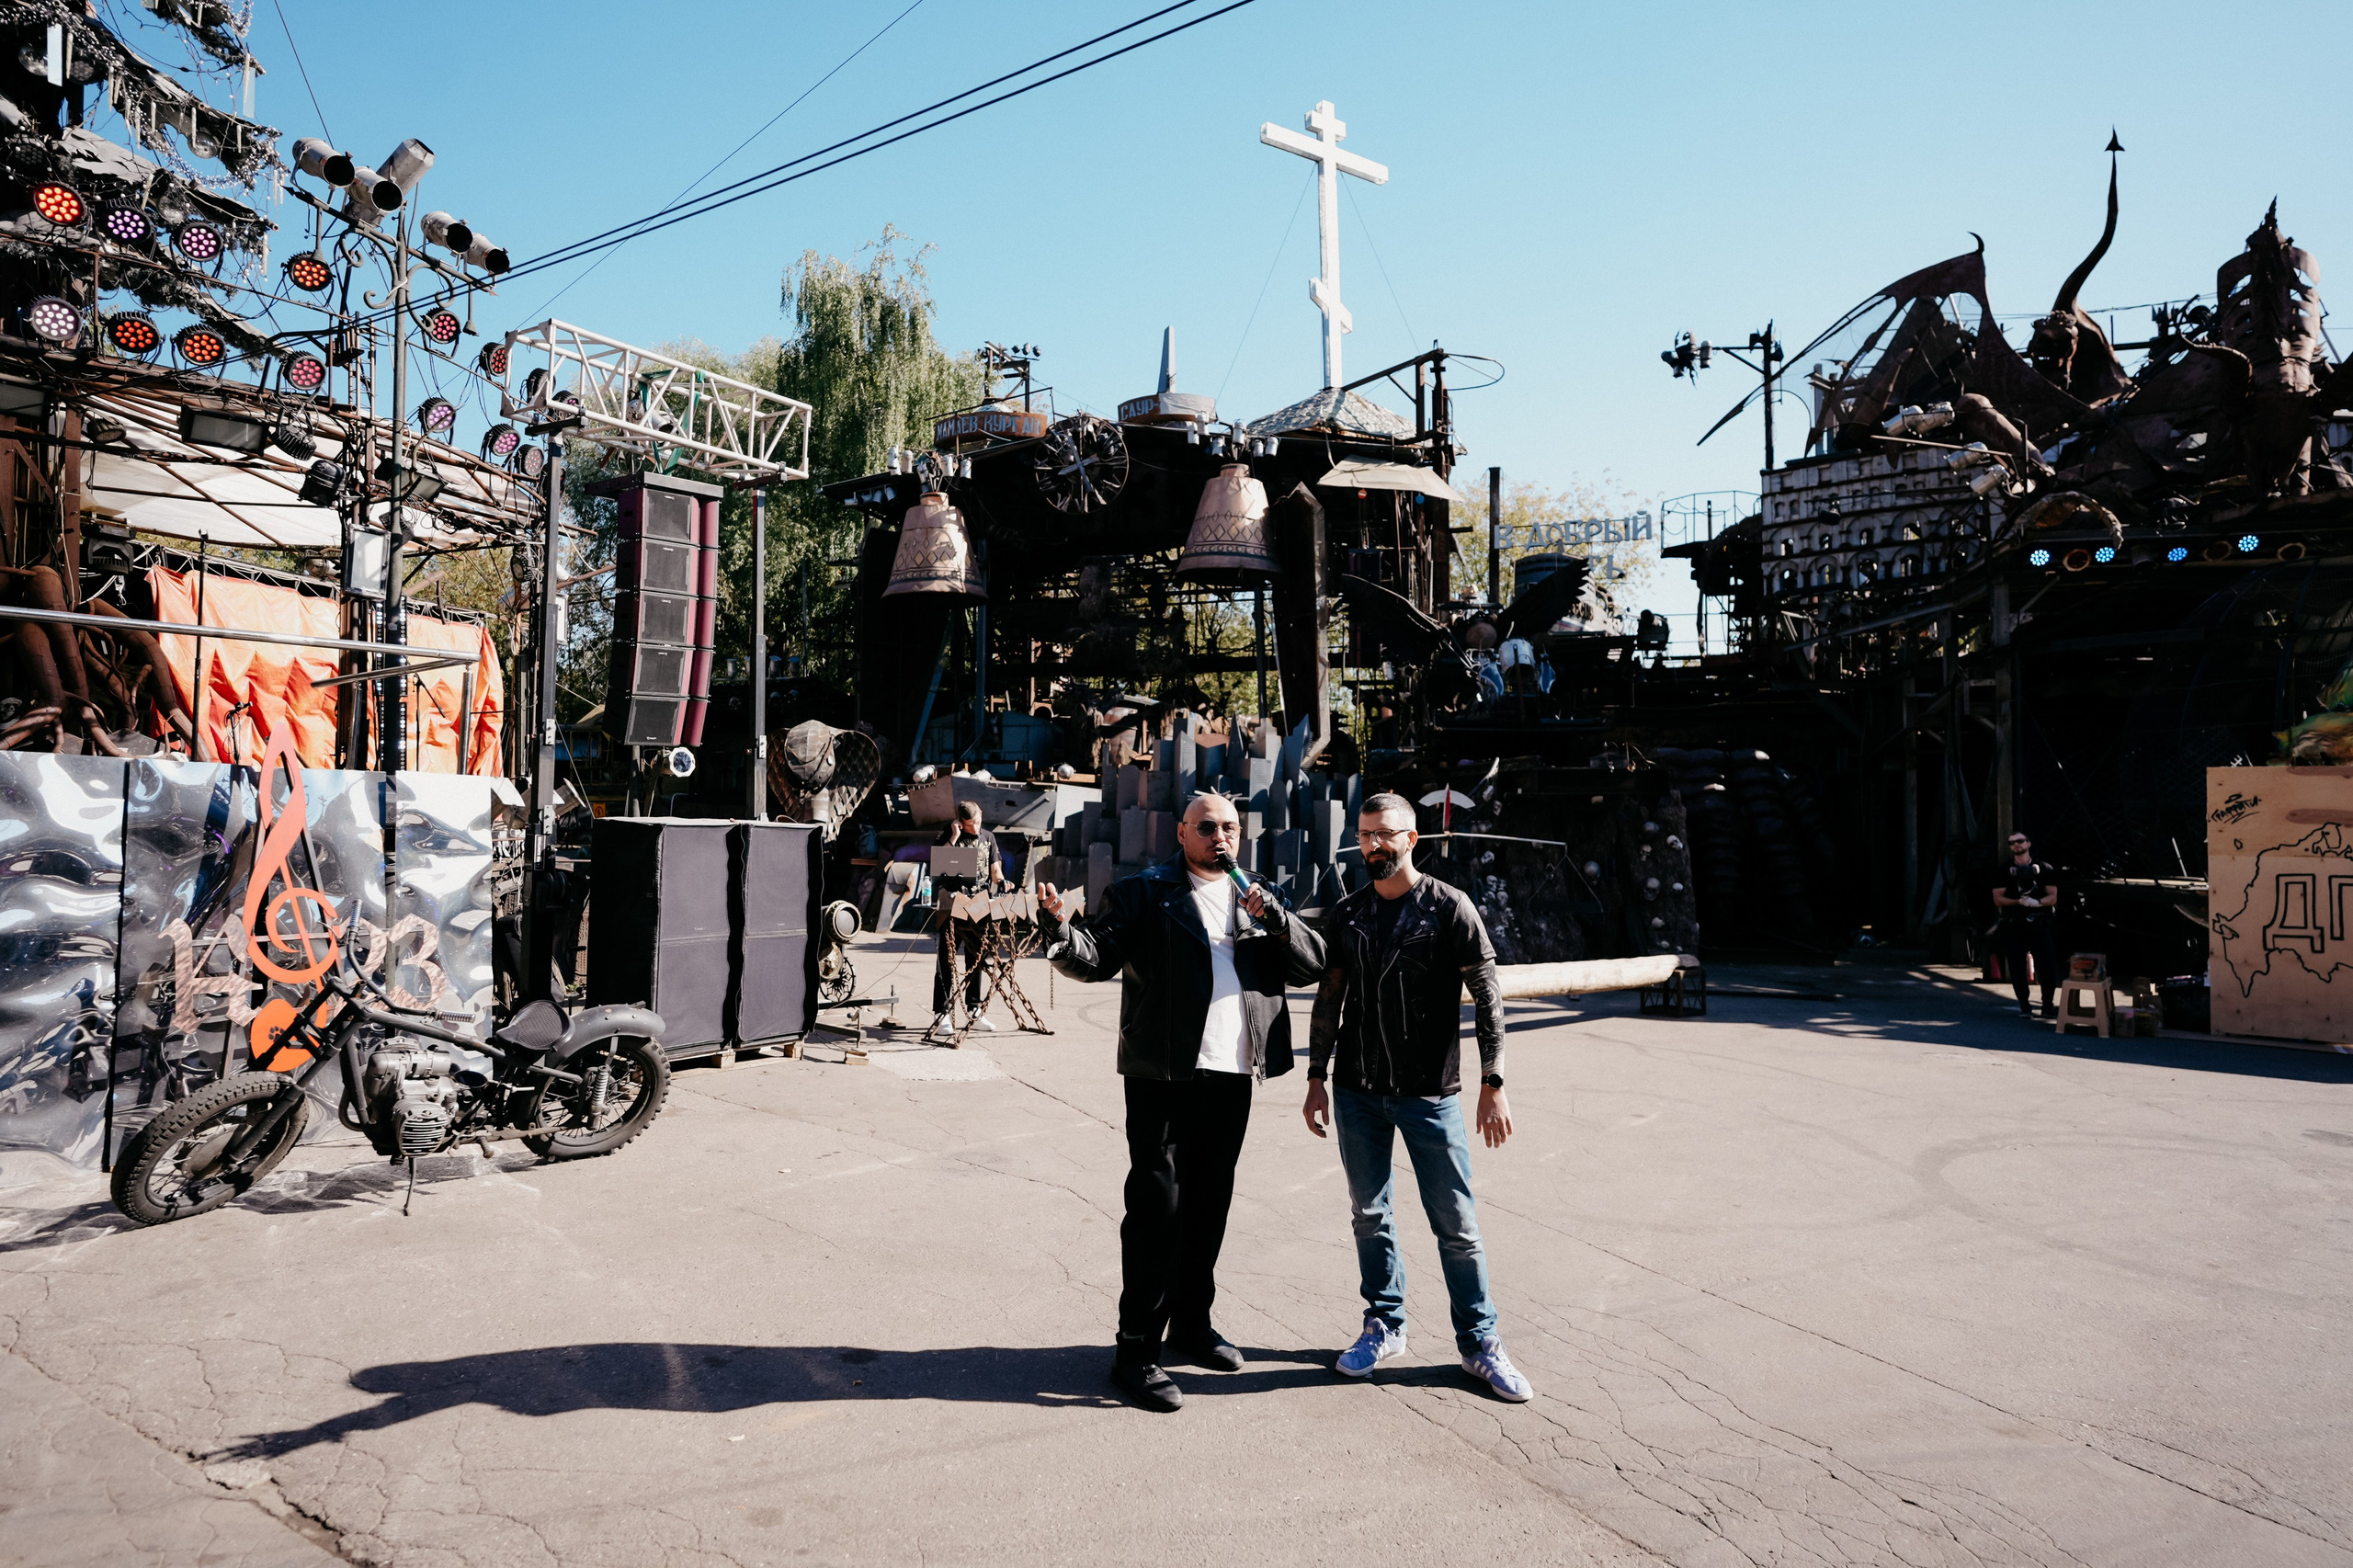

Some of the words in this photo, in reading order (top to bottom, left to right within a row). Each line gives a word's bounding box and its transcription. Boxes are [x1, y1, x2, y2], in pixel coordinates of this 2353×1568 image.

[983, 415, 1041, 435] КУРГАН
[1494, 524, 1514, 550] В
[1524, 510, 1652, 551] ДОБРЫЙ
